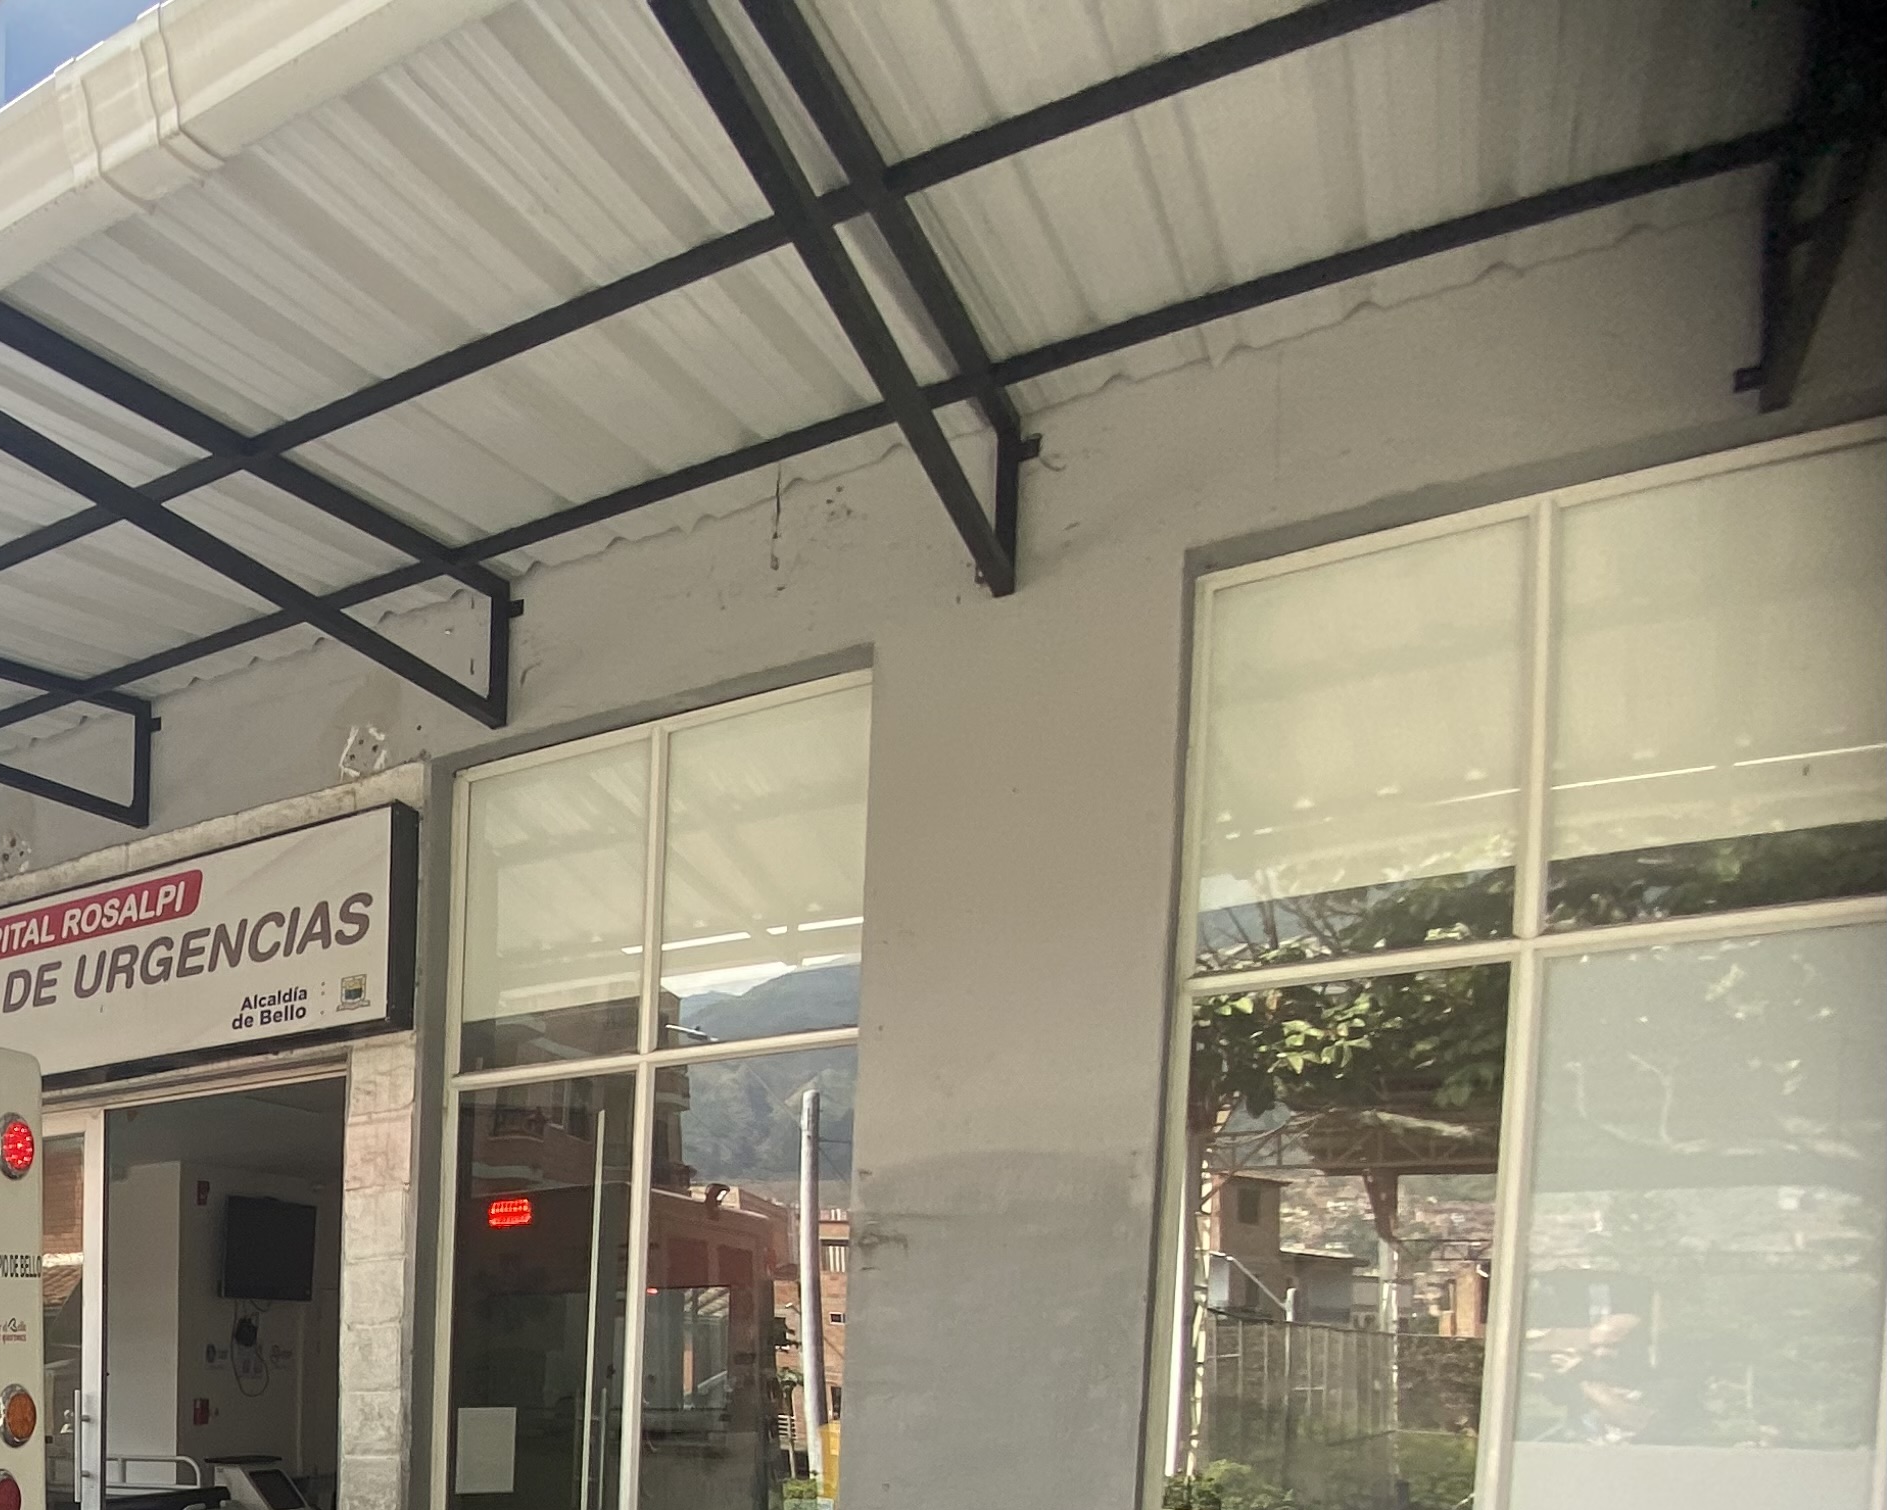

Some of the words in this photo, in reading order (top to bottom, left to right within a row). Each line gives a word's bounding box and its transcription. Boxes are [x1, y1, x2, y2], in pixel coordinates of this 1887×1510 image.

[61, 880, 186, 939] ROSALPI
[2, 960, 63, 1014] DE
[73, 891, 374, 999] URGENCIAS
[240, 986, 308, 1012] Alcaldía
[231, 1013, 254, 1031] de
[260, 1003, 307, 1026] Bello
[9, 1254, 19, 1278] DE
[20, 1254, 42, 1278] BELLO
